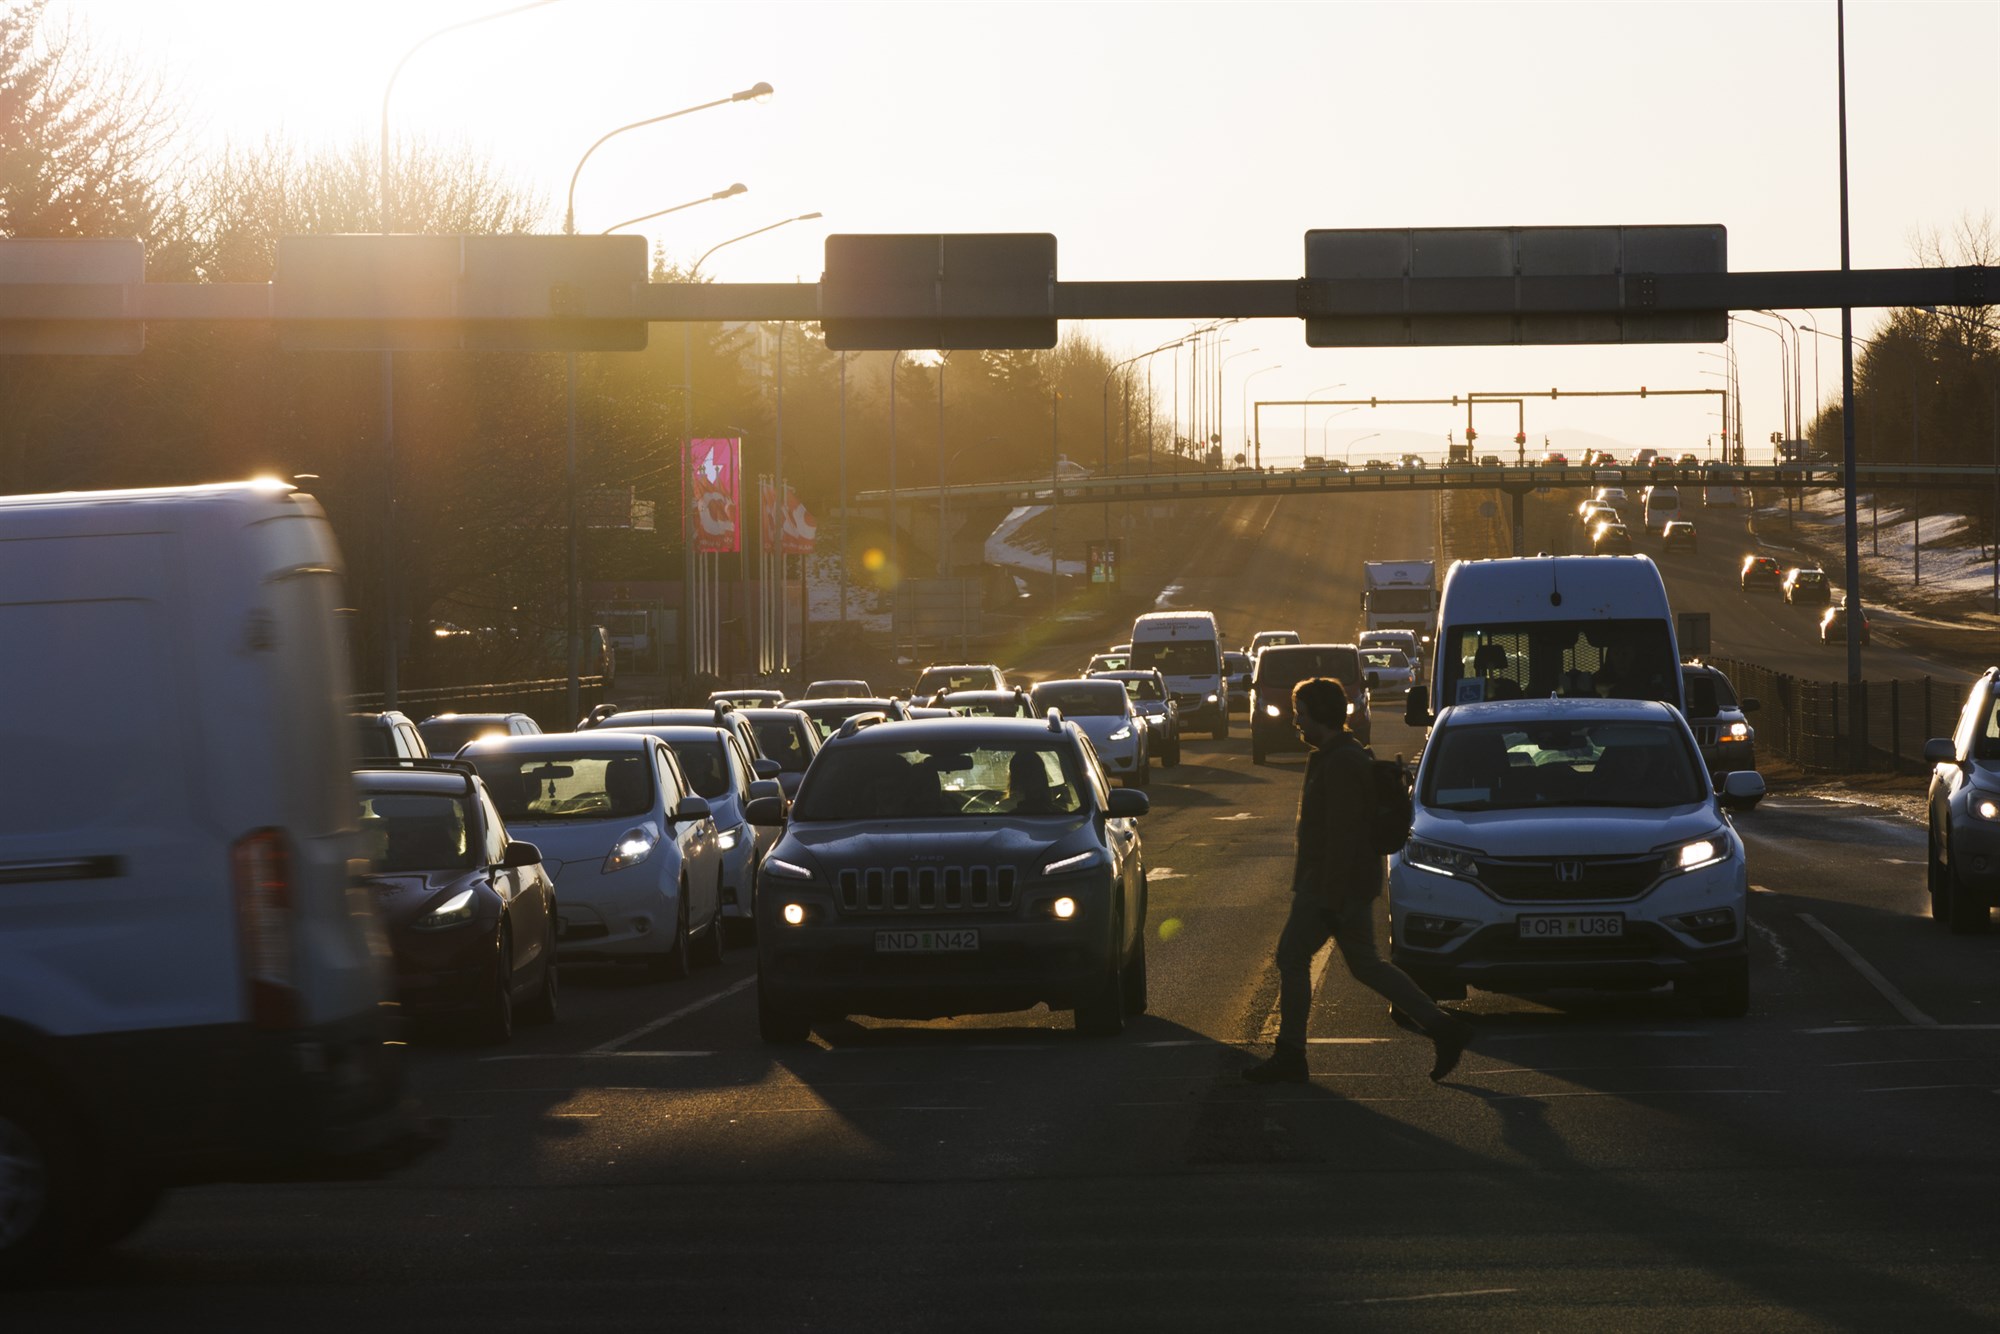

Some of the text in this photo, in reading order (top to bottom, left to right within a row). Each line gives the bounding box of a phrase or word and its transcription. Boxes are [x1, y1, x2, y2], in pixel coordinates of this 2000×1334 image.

[1534, 919, 1562, 935] OR
[1580, 918, 1618, 934] U36
[887, 932, 975, 949] ND N42
